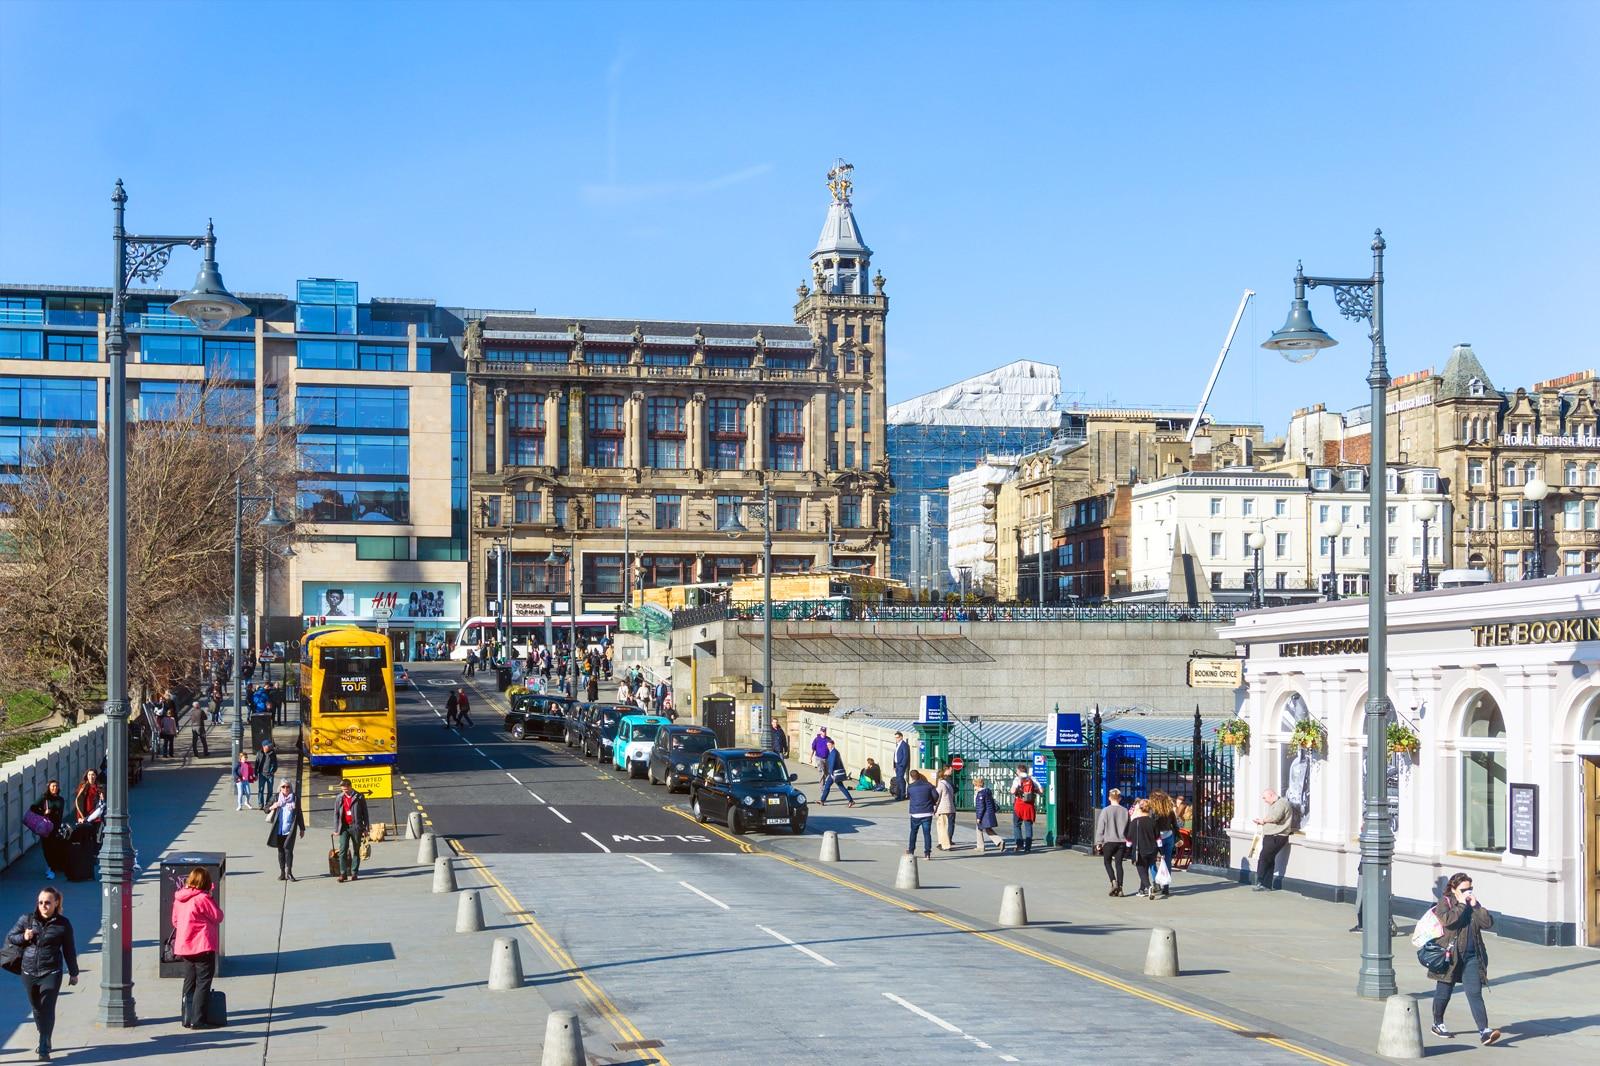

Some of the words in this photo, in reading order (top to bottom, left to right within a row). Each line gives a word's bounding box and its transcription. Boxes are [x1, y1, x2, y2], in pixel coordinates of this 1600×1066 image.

[1504, 433, 1535, 446] ROYAL
[1537, 434, 1575, 446] BRITISH
[372, 592, 397, 608] H&M
[1471, 623, 1512, 647] THE
[1194, 669, 1218, 677] BOOKING
[1219, 670, 1237, 678] OFFICE
[341, 683, 367, 692] TOUR
[612, 834, 712, 843] SLOW
